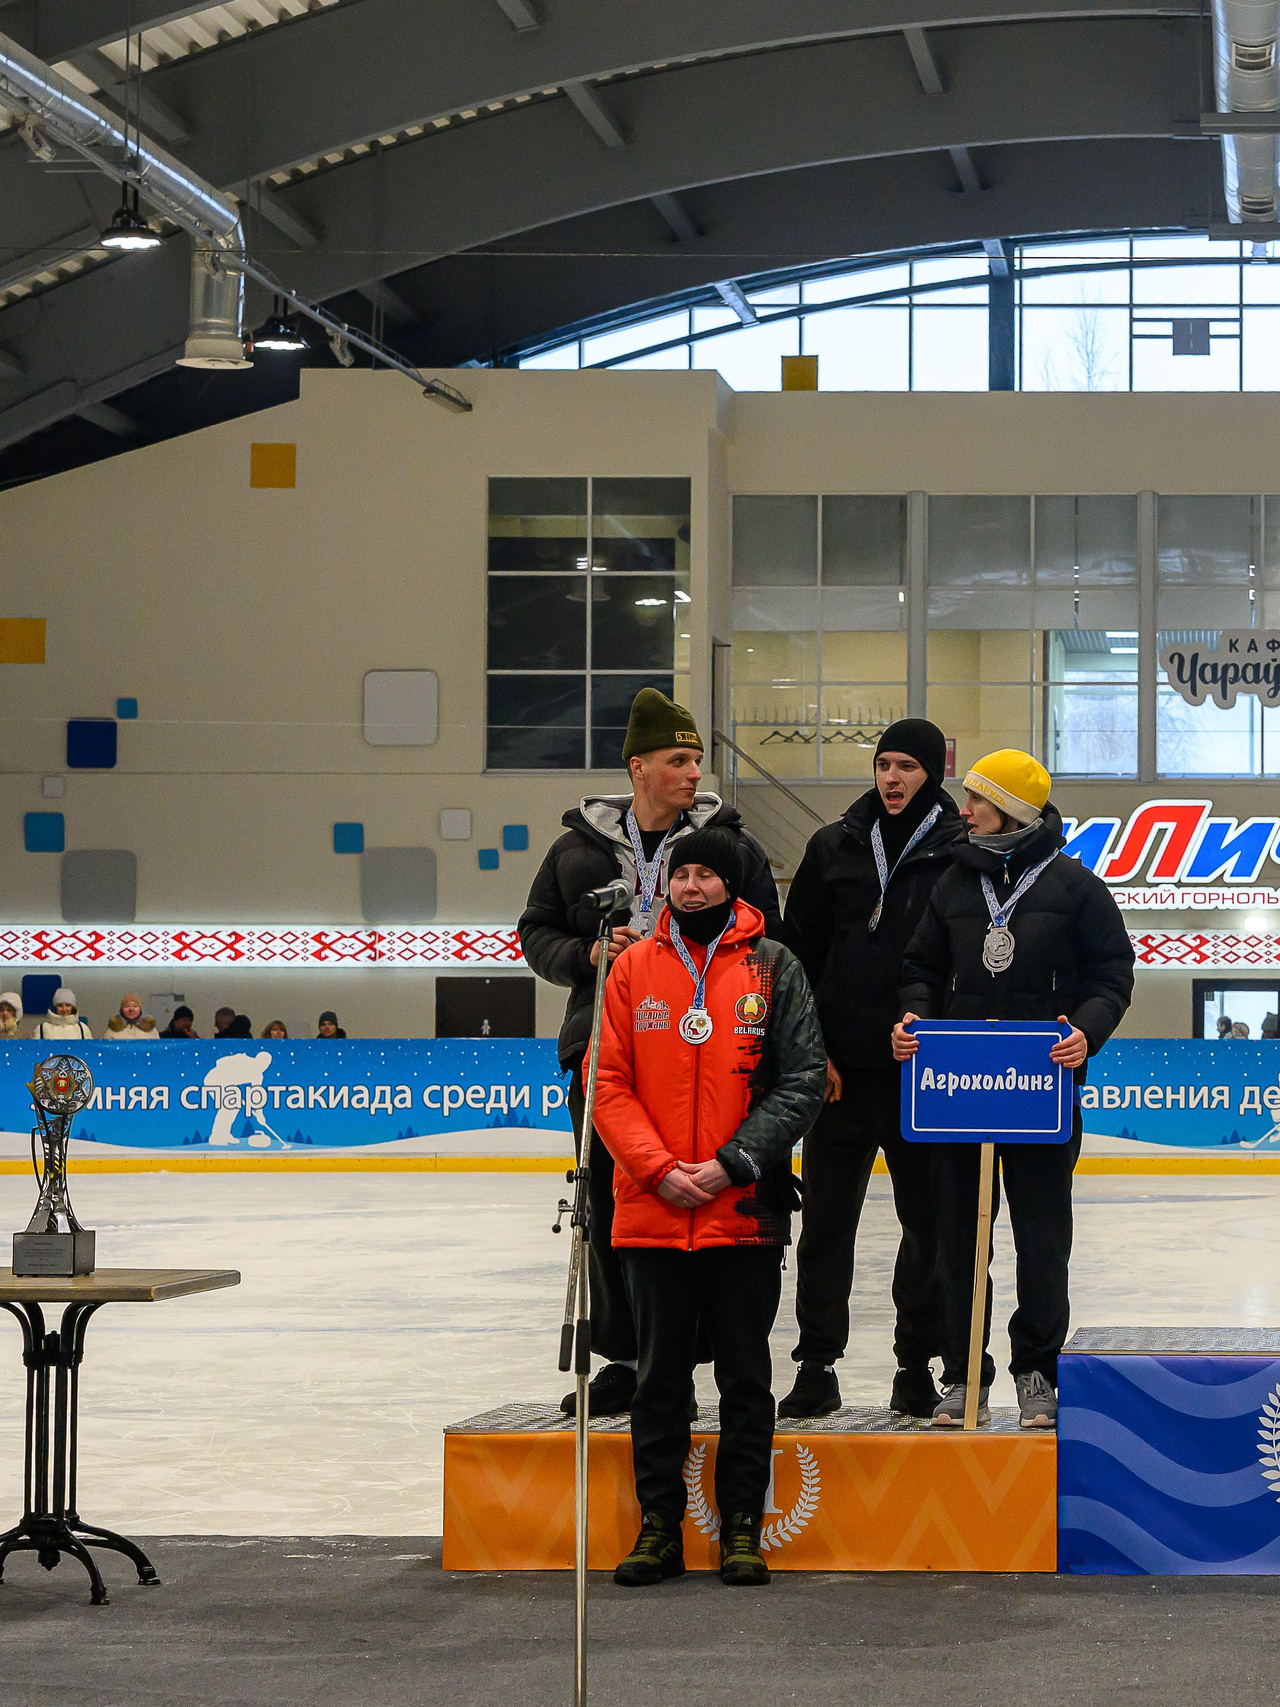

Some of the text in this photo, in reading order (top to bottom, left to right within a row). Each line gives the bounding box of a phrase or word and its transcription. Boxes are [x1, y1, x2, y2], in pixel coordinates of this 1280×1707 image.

[1113, 887, 1175, 905] СКИЙ
[920, 1066, 1054, 1097] Агрохолдинг
[180, 1084, 412, 1118] спартакиада
[422, 1084, 530, 1117] среди
[1081, 1084, 1230, 1109] авления
